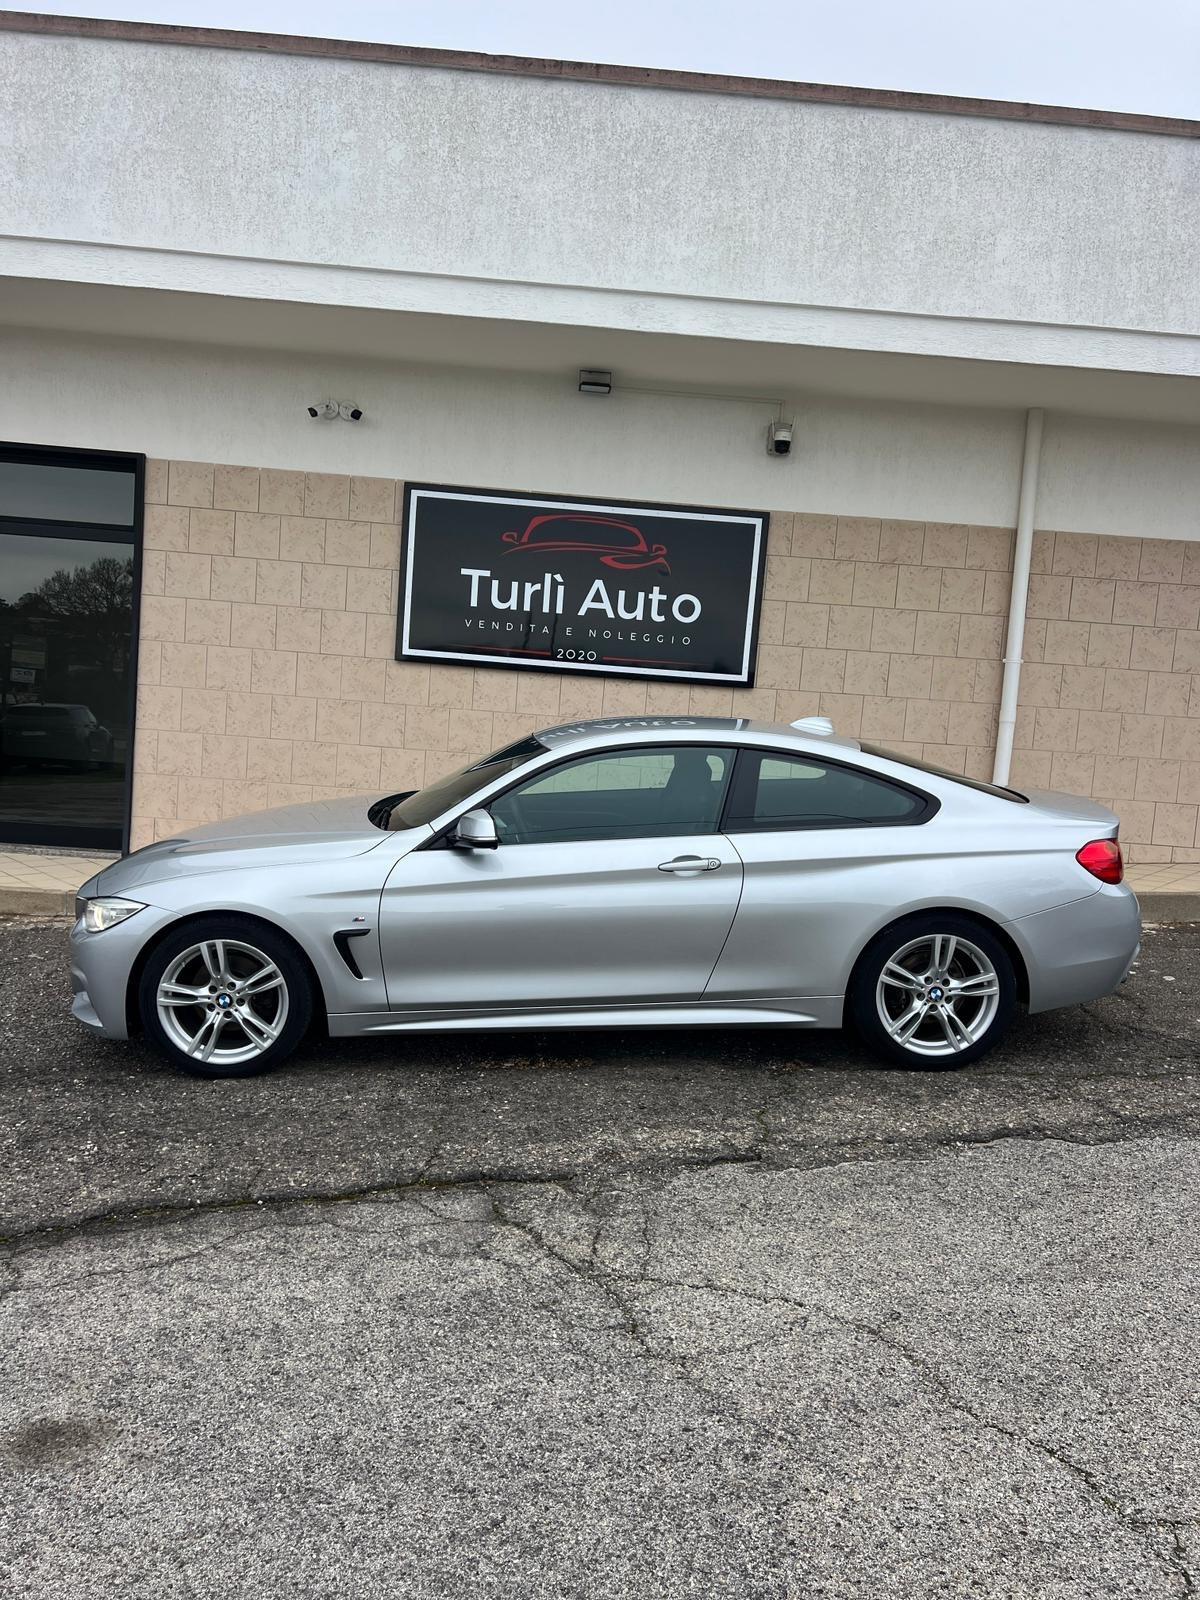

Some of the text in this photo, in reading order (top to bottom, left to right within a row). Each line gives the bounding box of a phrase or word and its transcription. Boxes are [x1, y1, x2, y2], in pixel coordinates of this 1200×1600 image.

[460, 568, 702, 624] Turlì Auto
[464, 619, 691, 645] VENDITA E NOLEGGIO
[556, 648, 597, 661] 2020
